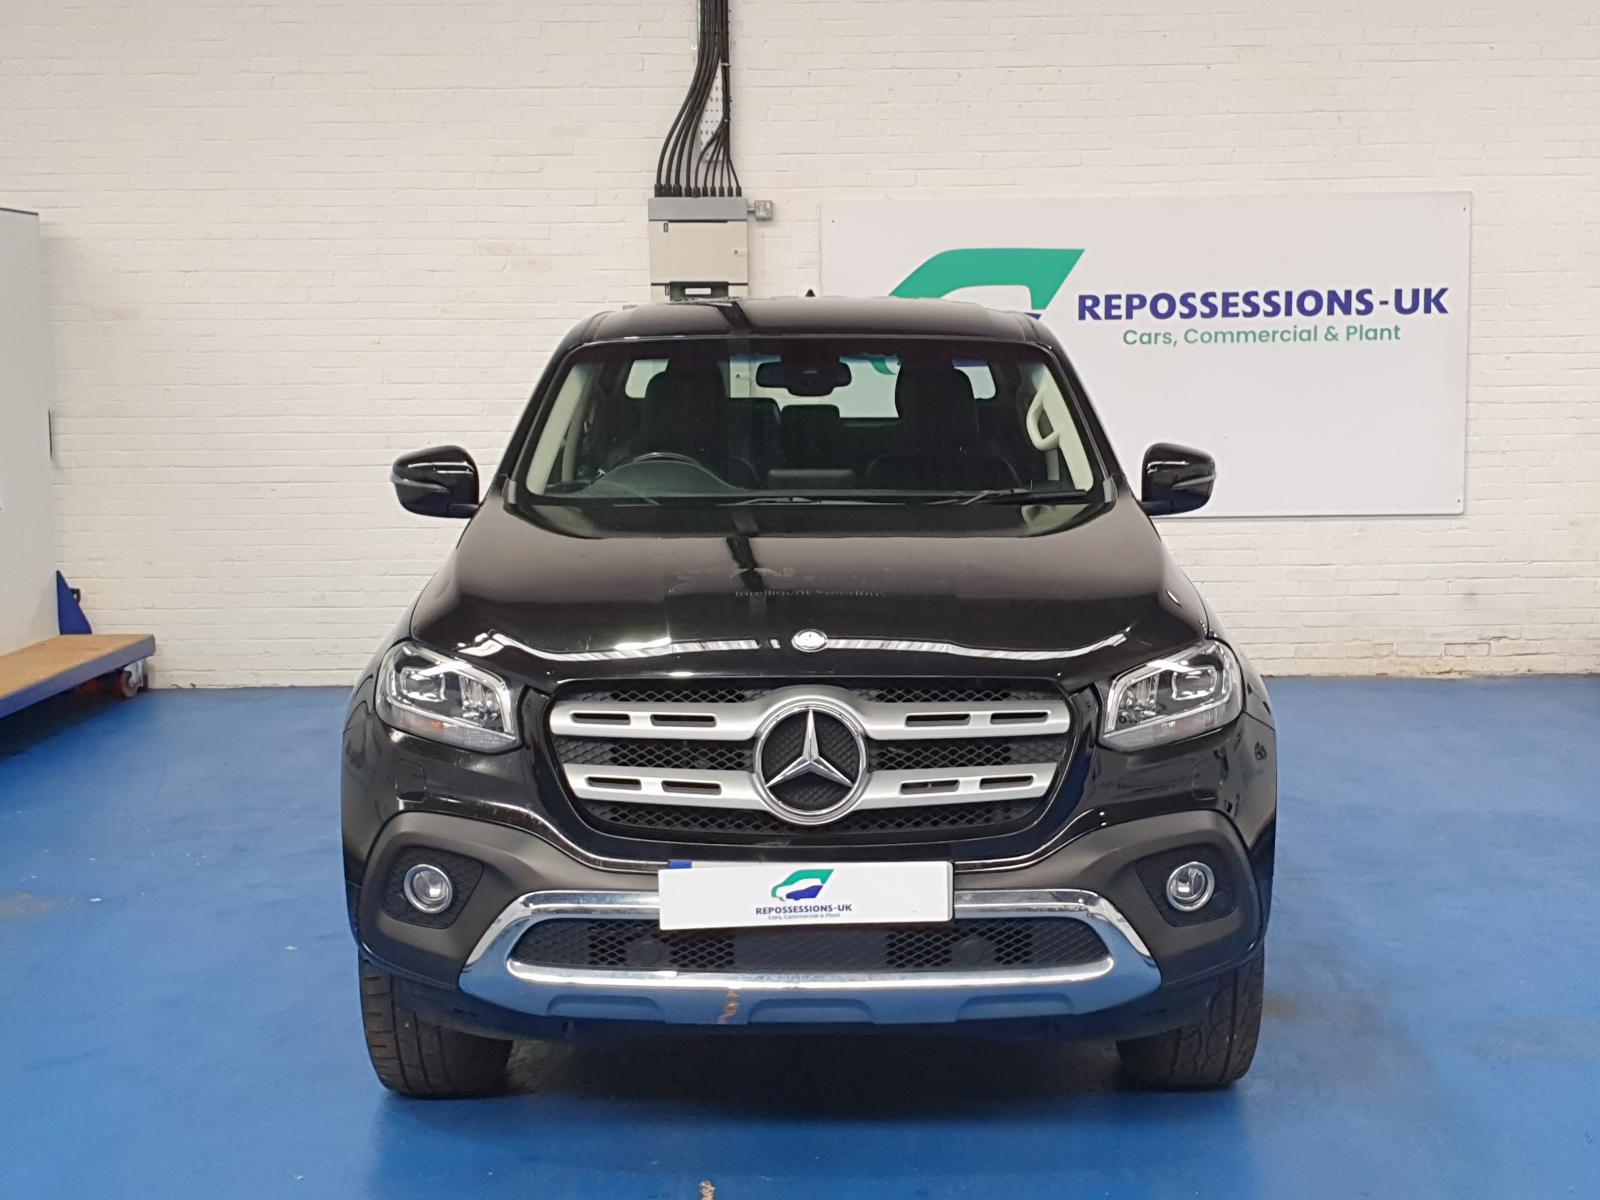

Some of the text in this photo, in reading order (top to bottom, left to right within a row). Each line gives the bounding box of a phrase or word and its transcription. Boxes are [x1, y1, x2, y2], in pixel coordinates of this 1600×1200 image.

[1077, 287, 1449, 321] REPOSSESSIONS-UK
[1123, 323, 1401, 347] Cars, Commercial & Plant
[756, 904, 852, 914] REPOSSESSIONS-UK
